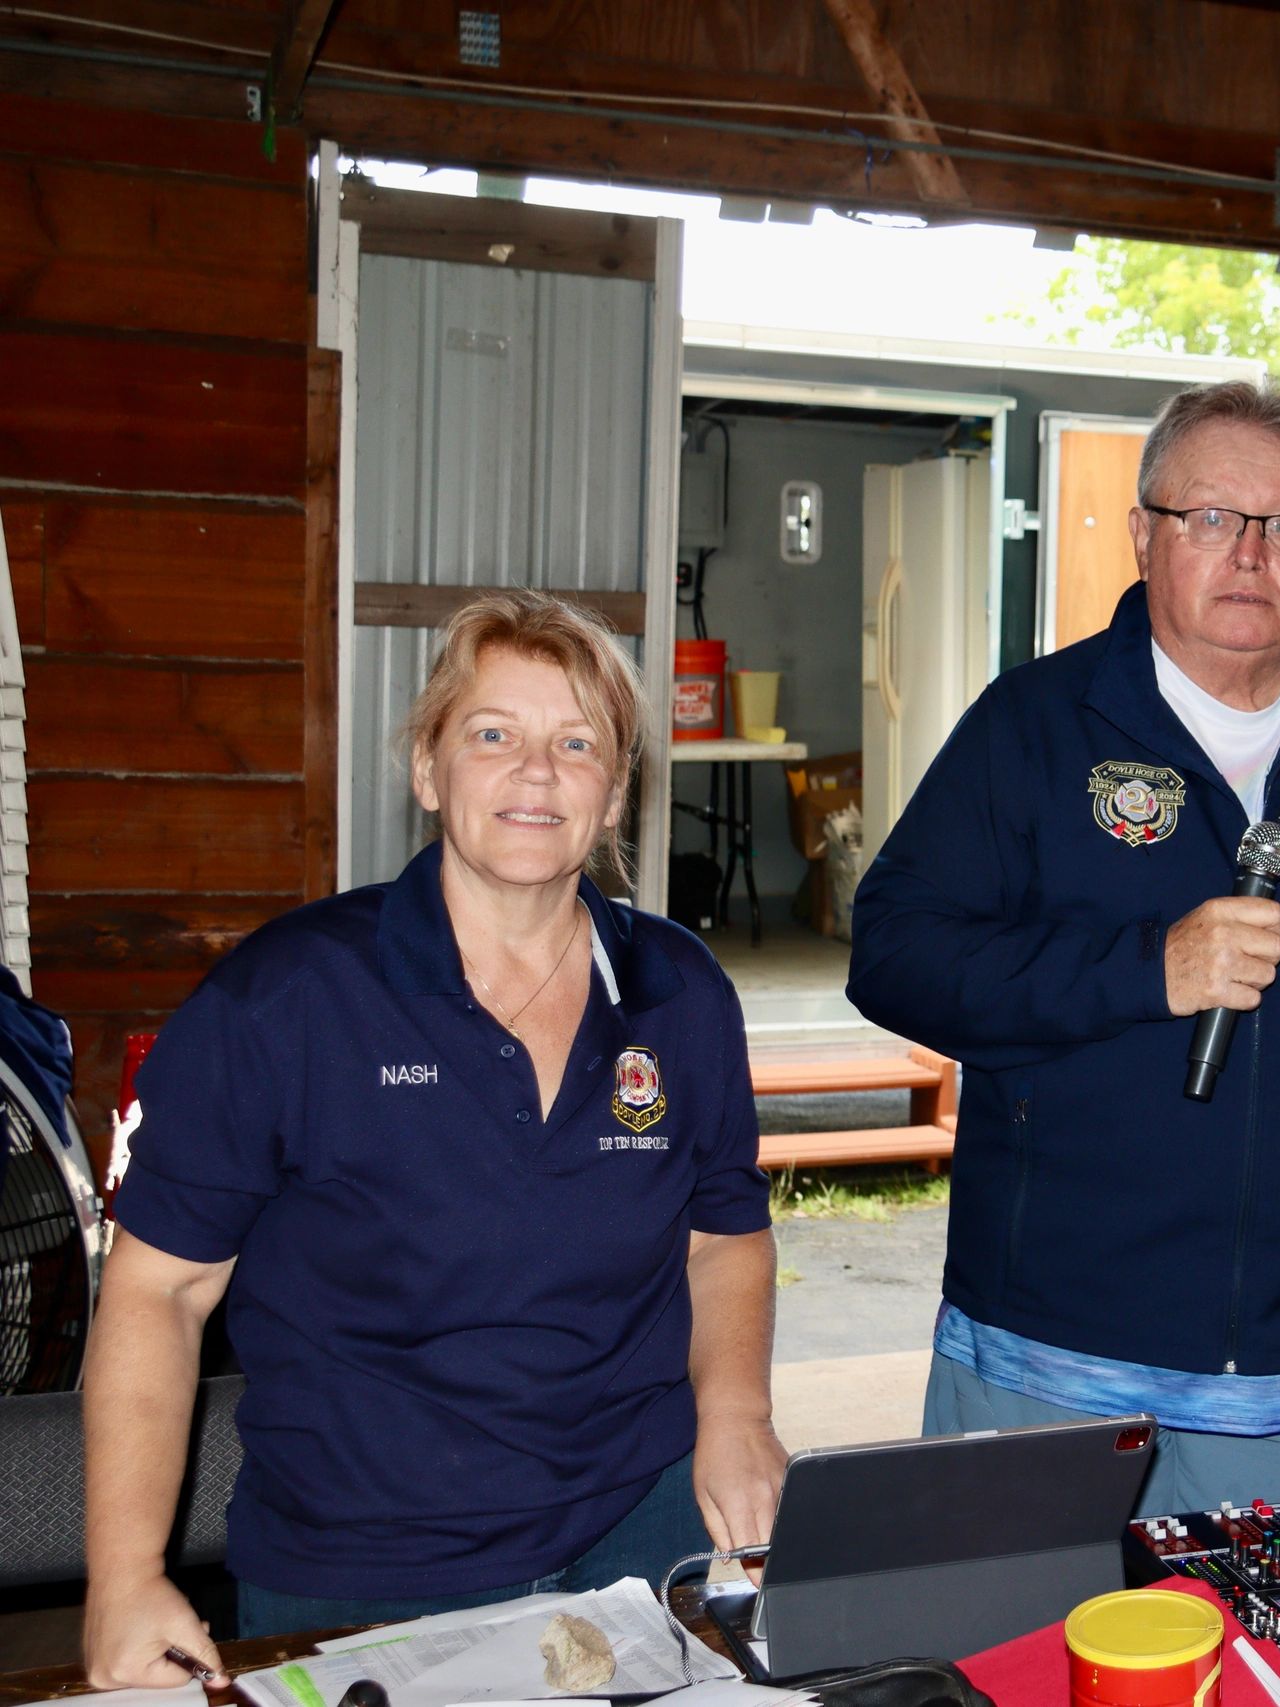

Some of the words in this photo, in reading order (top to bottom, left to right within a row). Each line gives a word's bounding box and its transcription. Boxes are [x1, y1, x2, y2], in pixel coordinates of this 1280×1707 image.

[1107, 765, 1133, 775] DOYLE
[1135, 768, 1155, 778] HOSE
[1125, 787, 1147, 815] 2
[381, 1064, 438, 1086] NASH
[619, 1105, 640, 1128] DOYLE
[599, 1137, 613, 1150] TOP
[614, 1136, 630, 1149] TEN
